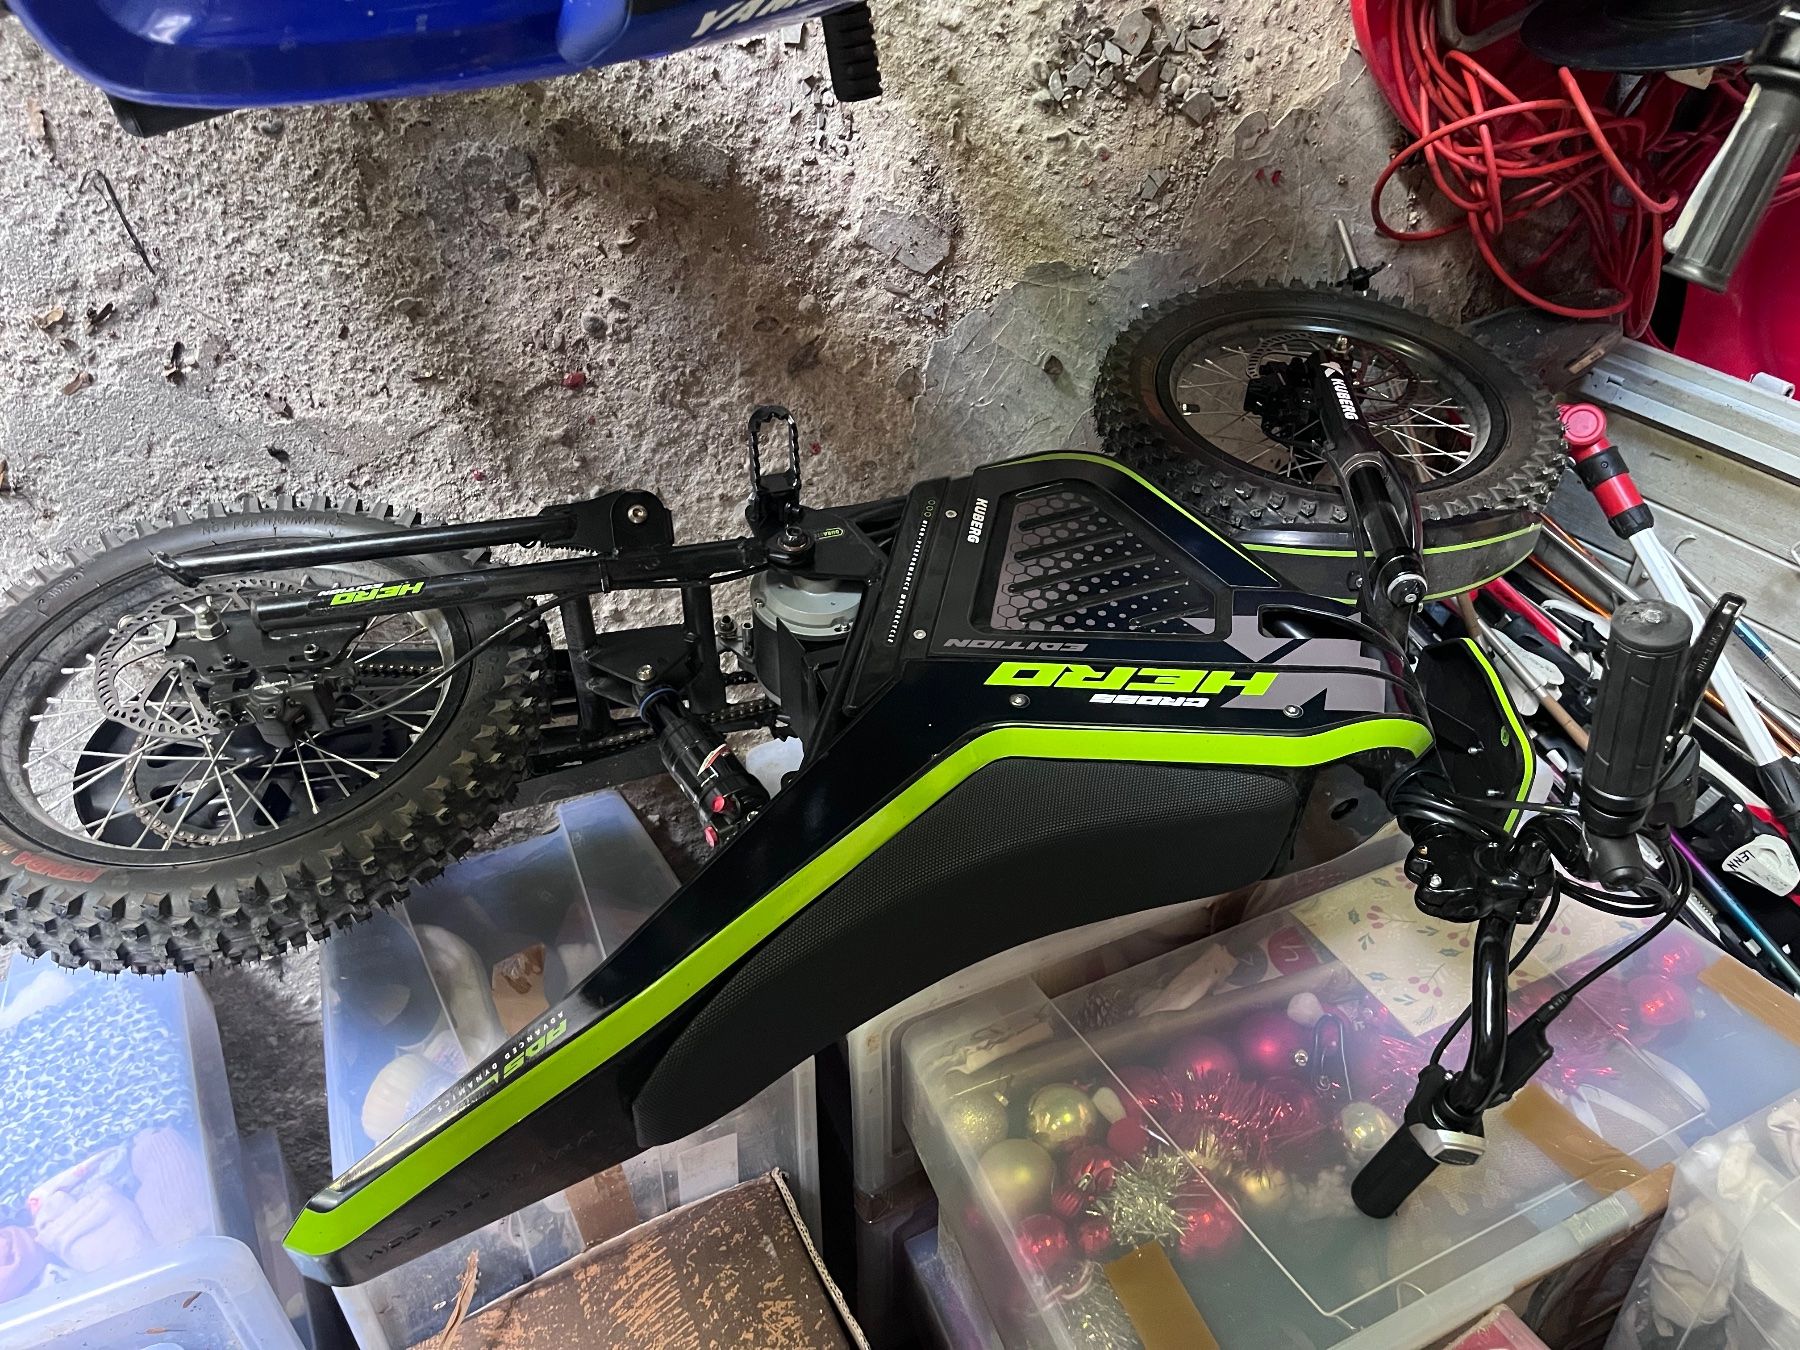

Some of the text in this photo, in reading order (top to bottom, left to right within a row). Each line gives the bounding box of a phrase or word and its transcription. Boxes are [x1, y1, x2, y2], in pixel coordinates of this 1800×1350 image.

[1330, 378, 1359, 420] KUBERG
[967, 497, 988, 544] KUBERG
[330, 582, 424, 606] HERO
[887, 519, 928, 643] HIGH-PERFORMANCE MOTORCYCLE
[944, 638, 1089, 652] EDITION
[983, 661, 1279, 696] HERO
[1089, 693, 1210, 708] CROSS
[1727, 849, 1756, 871] LENN
[504, 1010, 563, 1060] ADVANCED
[437, 1062, 498, 1113] DYNAMICS
